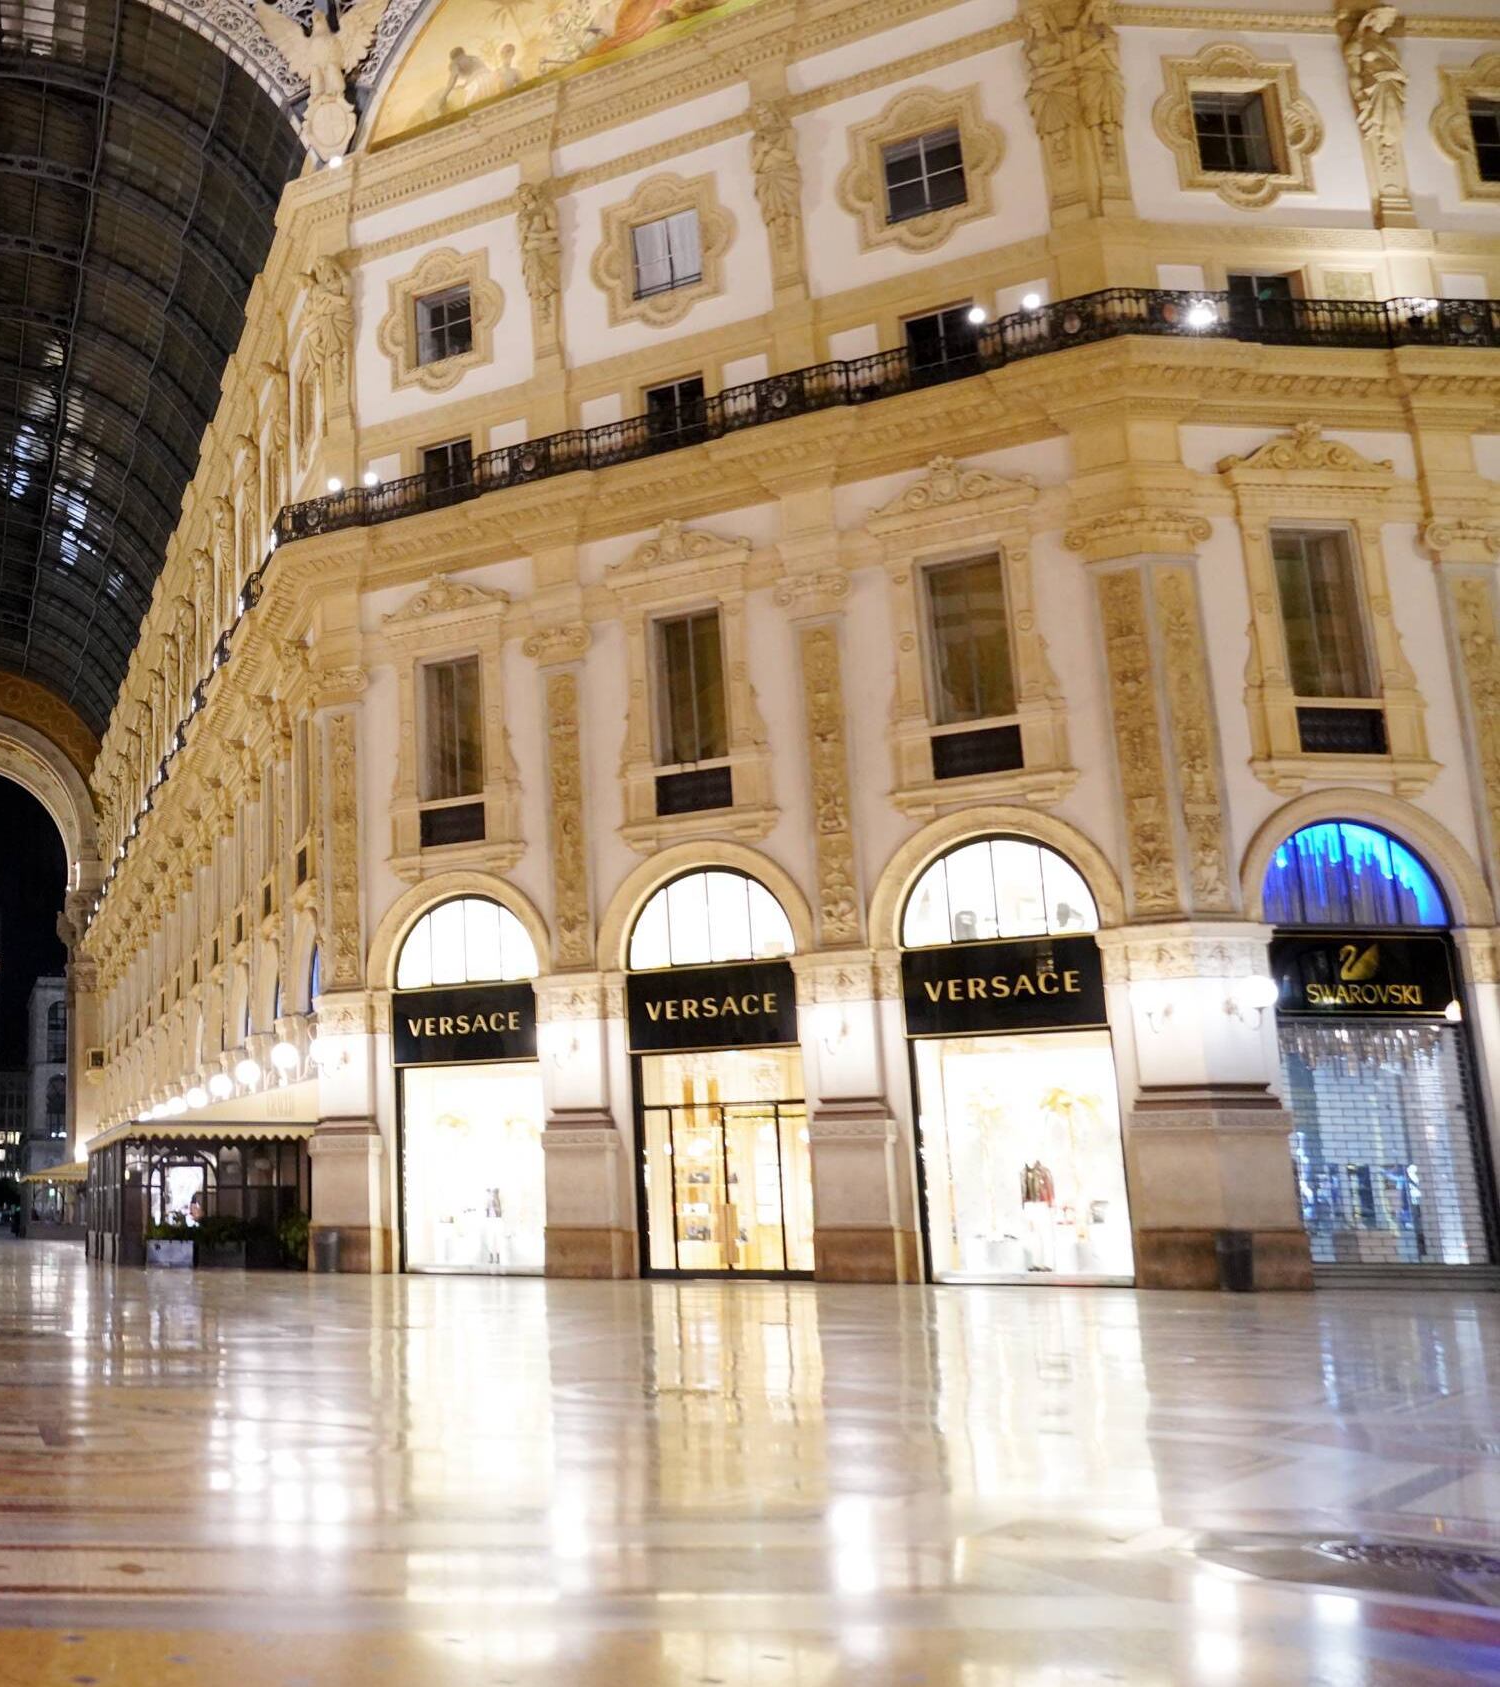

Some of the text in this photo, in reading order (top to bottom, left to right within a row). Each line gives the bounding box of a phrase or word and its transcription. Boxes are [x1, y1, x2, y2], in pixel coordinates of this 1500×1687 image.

[923, 970, 1082, 1002] VERSACE
[1306, 983, 1423, 1005] SWAROVSKI
[645, 993, 778, 1021] VERSACE
[407, 1011, 521, 1038] VERSACE
